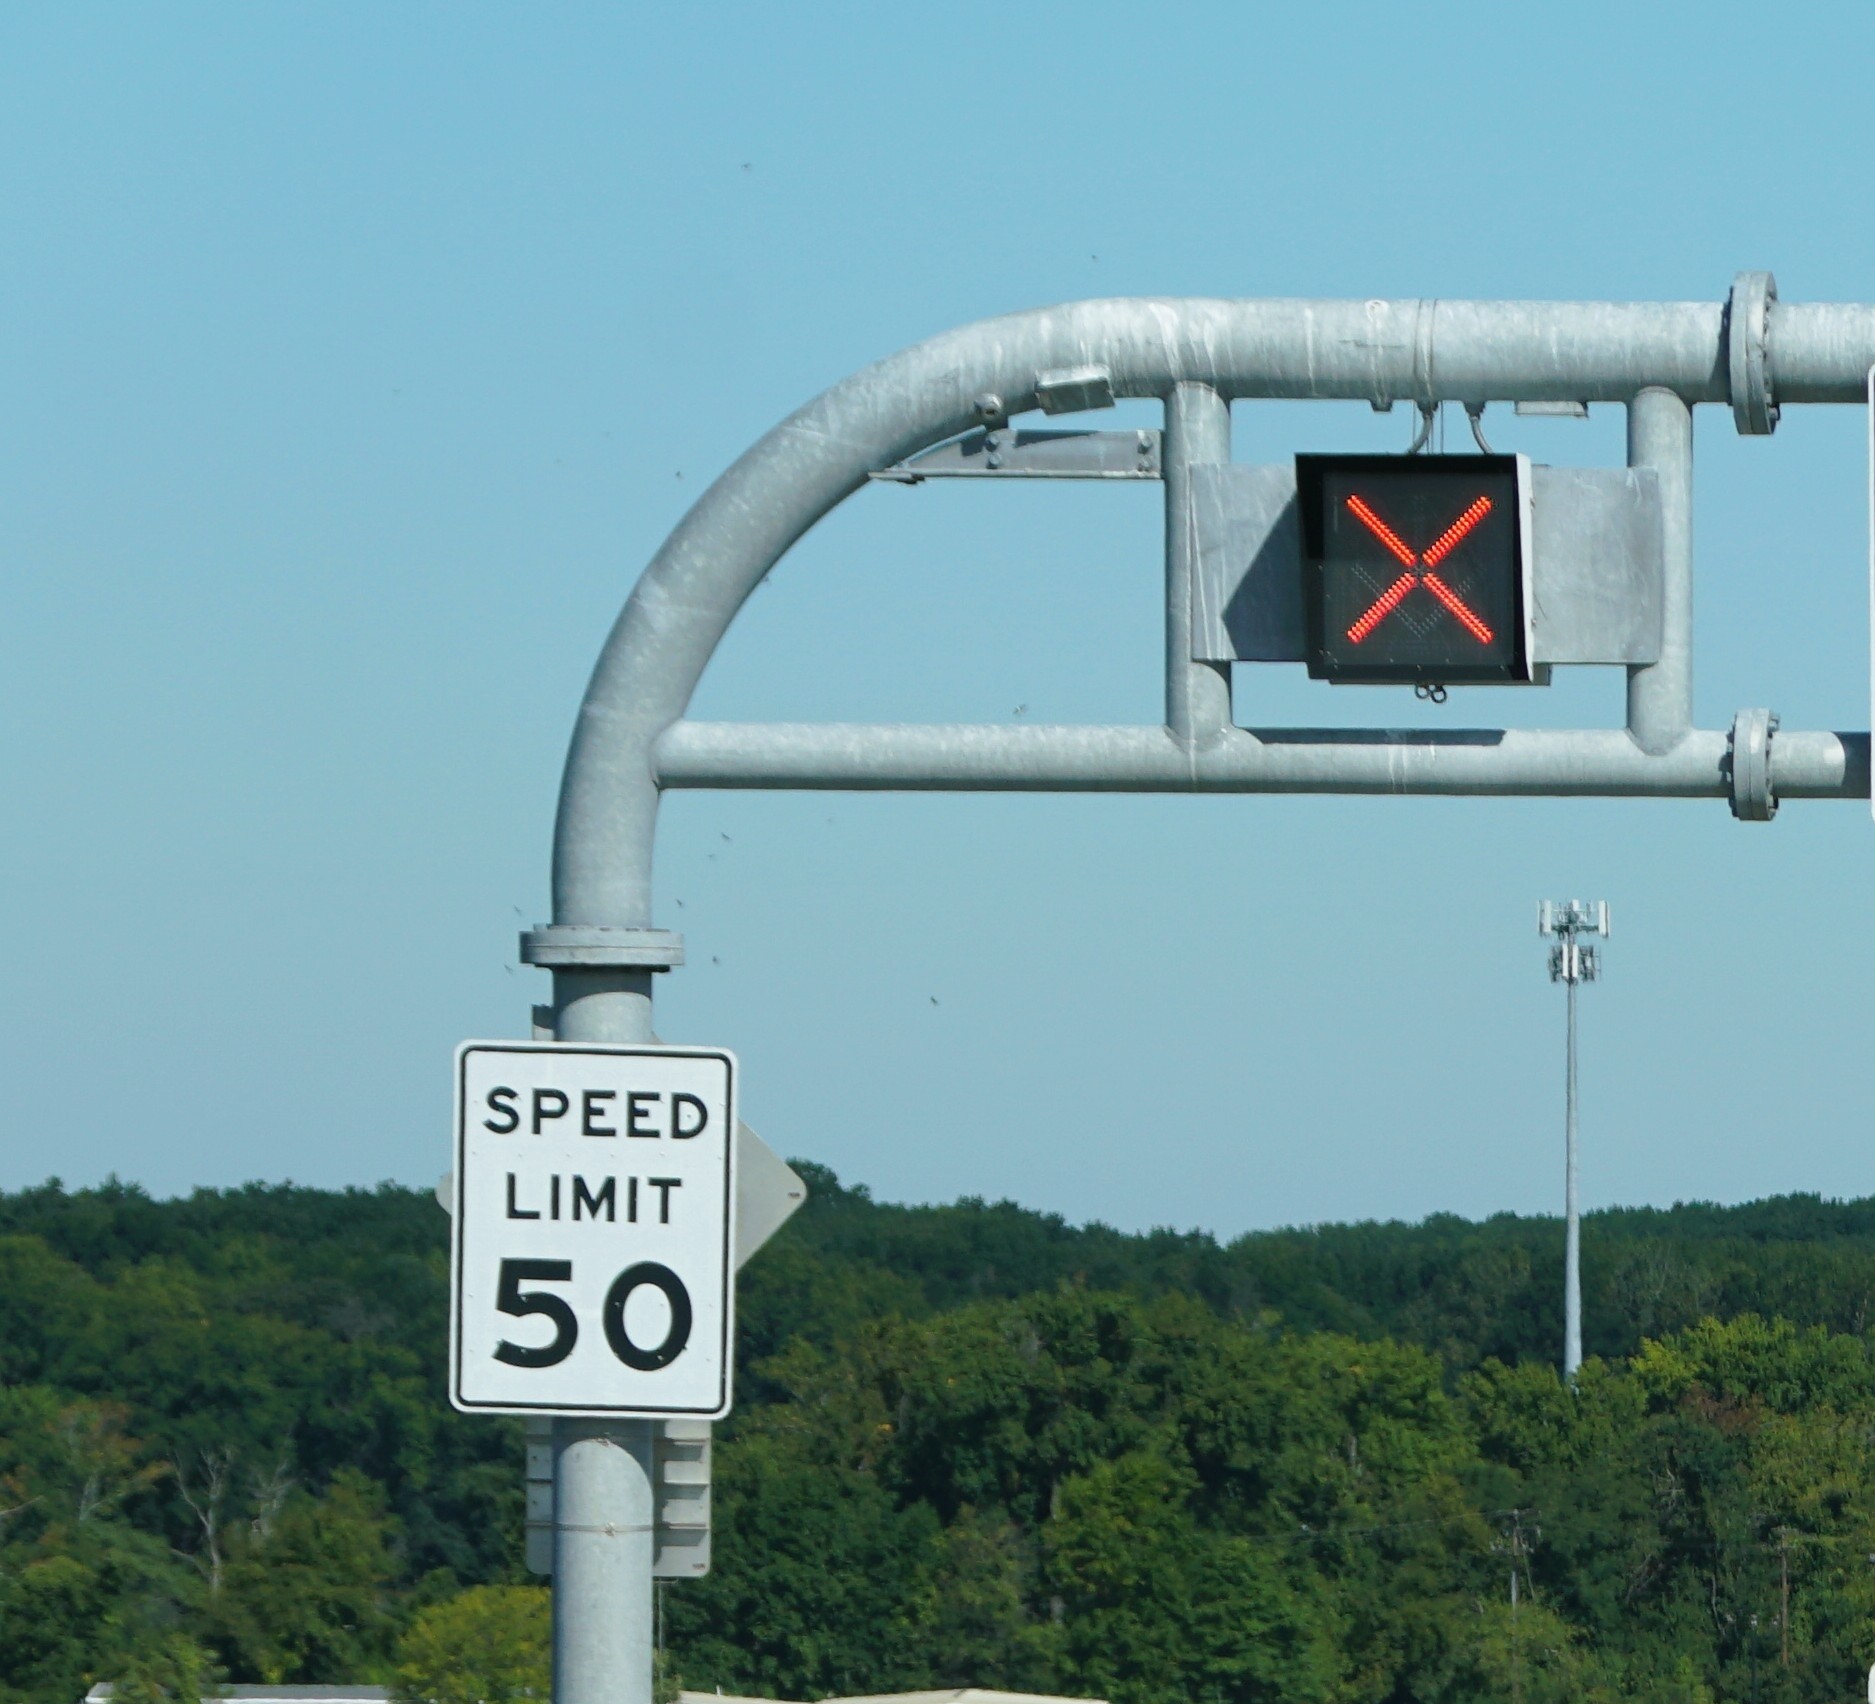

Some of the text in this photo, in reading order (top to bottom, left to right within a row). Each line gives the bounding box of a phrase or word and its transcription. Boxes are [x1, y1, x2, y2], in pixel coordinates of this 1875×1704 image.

[483, 1086, 708, 1140] SPEED
[505, 1171, 683, 1225] LIMIT
[492, 1258, 693, 1372] 50
